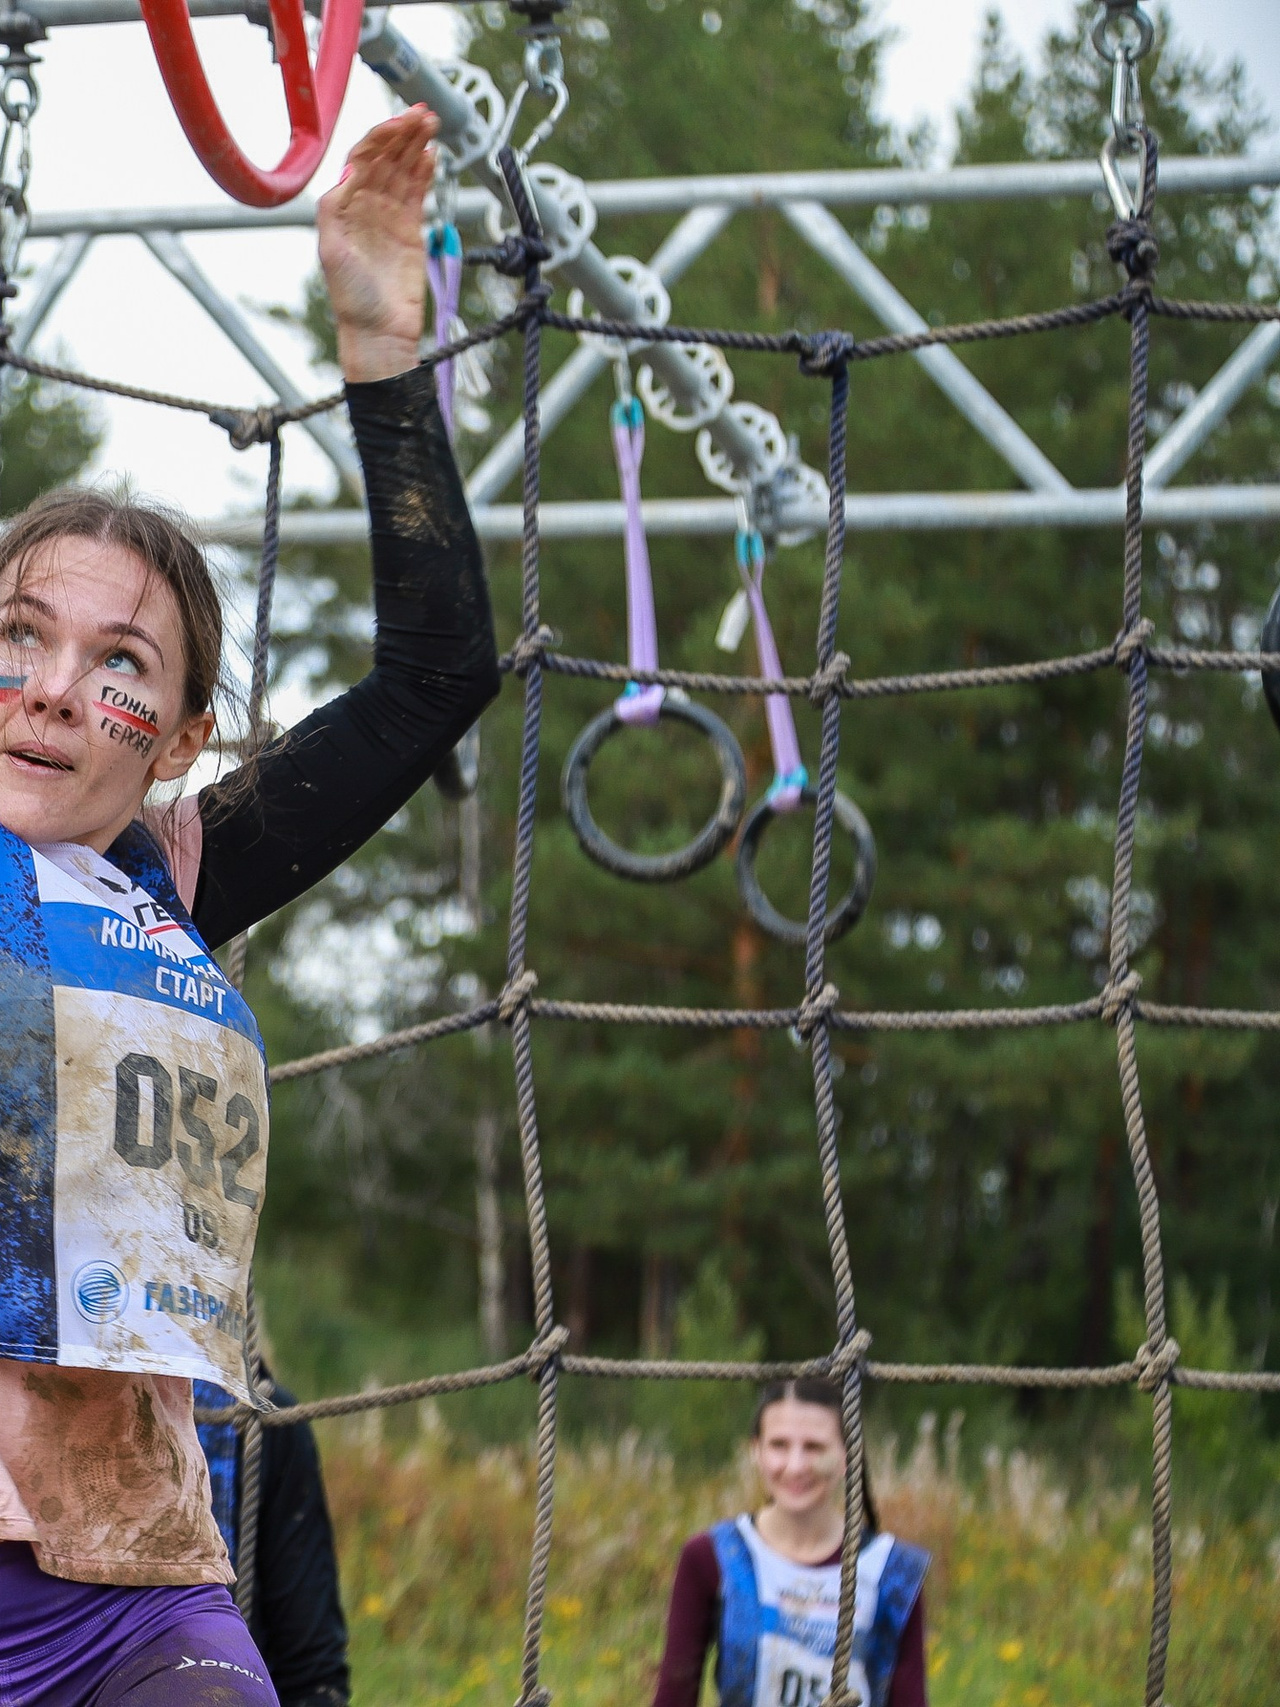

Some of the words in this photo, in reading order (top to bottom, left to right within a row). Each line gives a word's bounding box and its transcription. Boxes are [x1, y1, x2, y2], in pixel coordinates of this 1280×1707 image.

[100, 685, 158, 726] ГОНКА
[154, 965, 227, 1016] СТАРТ
[114, 1052, 260, 1212] 052
[200, 1658, 265, 1686] DEMIX
